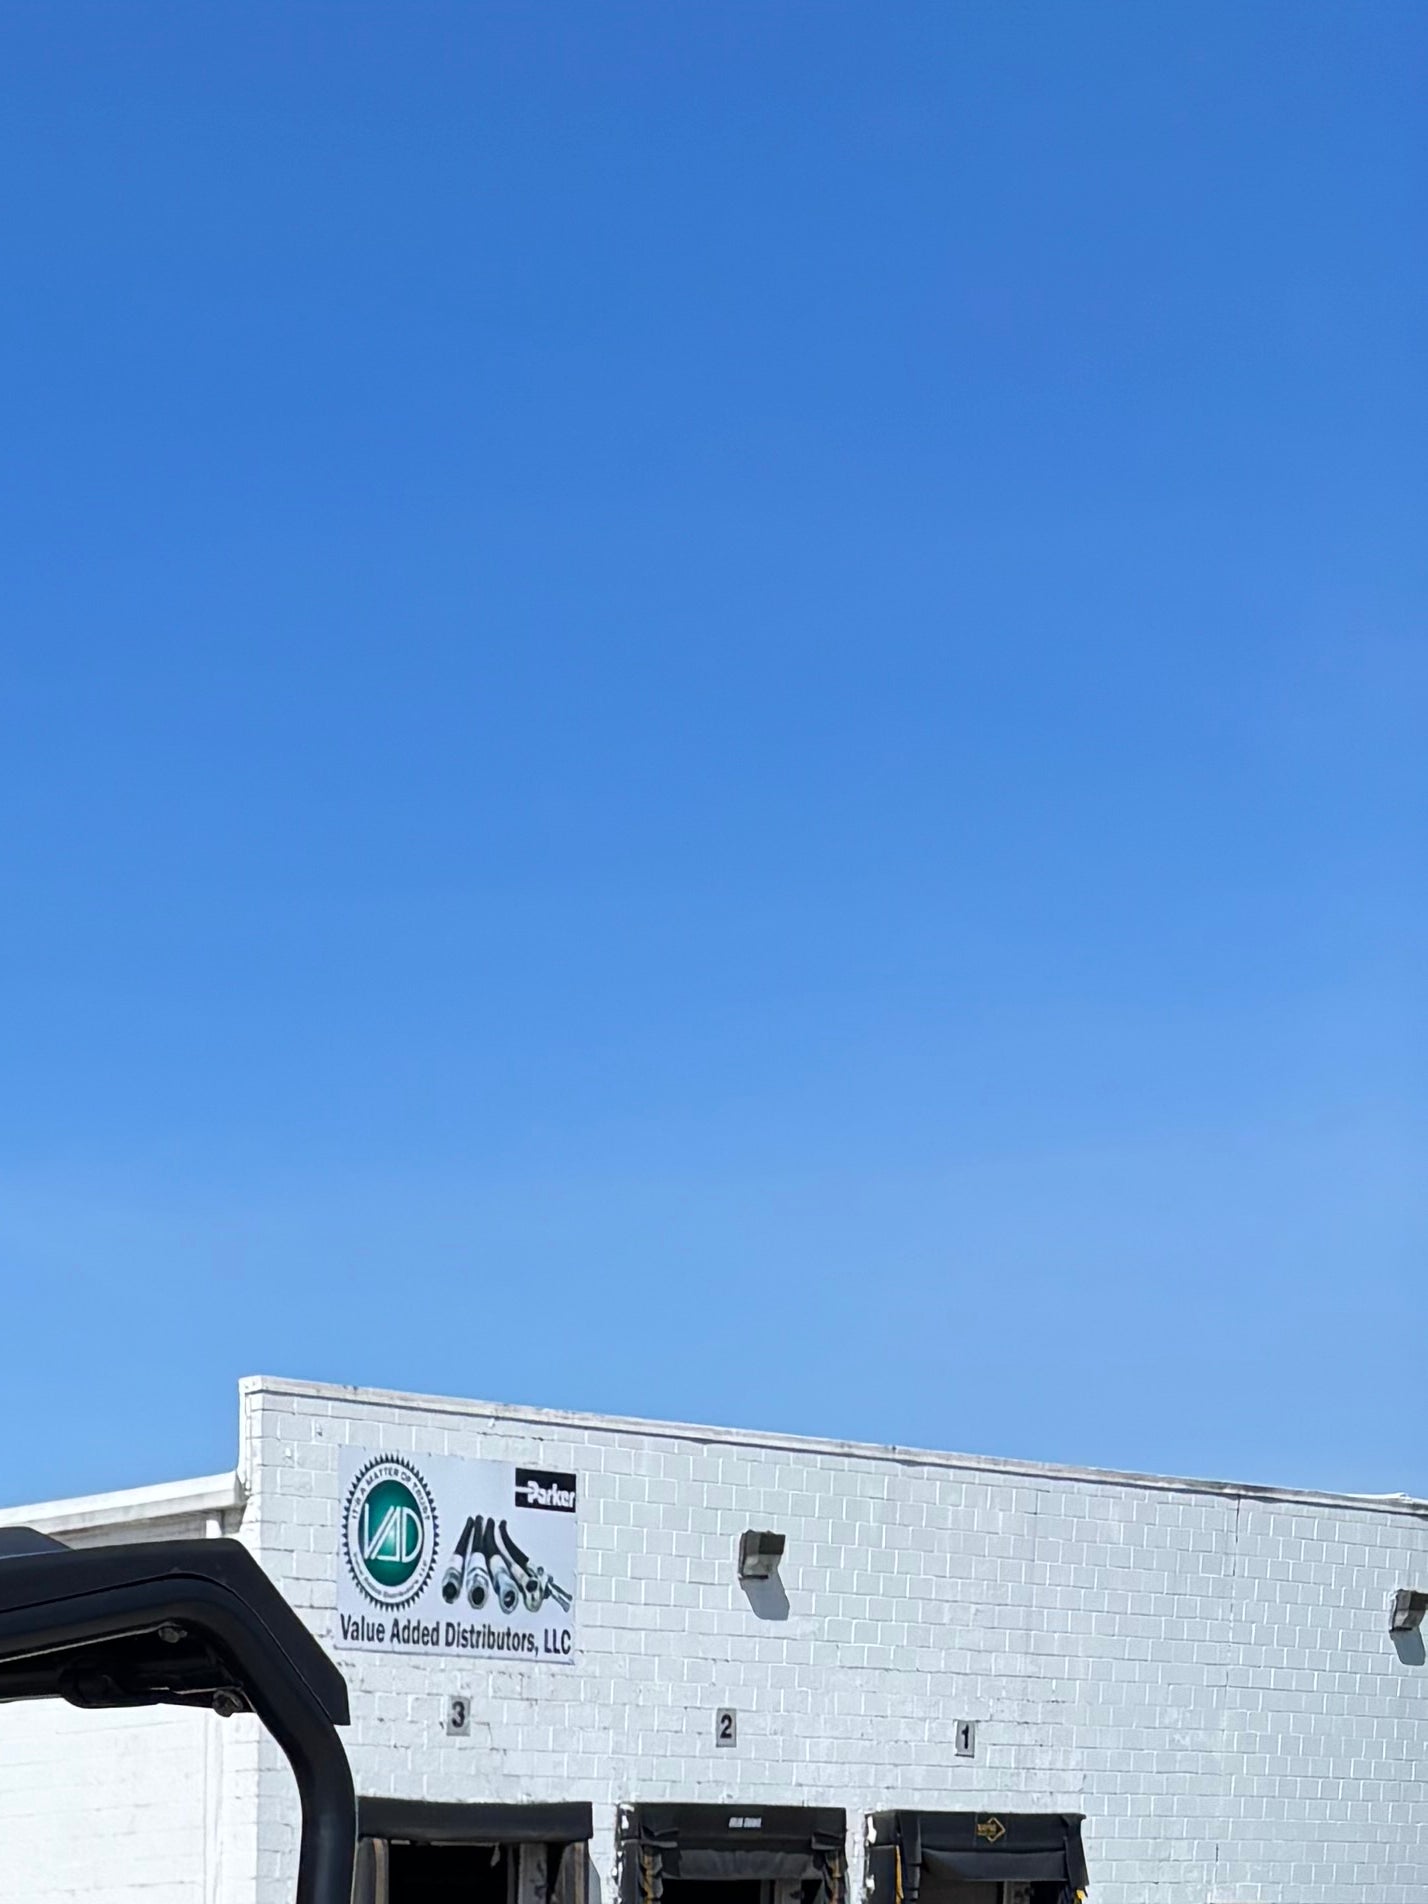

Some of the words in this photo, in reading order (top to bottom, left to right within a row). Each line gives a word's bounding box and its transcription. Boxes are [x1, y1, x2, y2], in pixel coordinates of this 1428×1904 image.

[527, 1480, 575, 1508] Parker
[364, 1503, 423, 1563] VAD
[340, 1614, 385, 1643] Value
[390, 1618, 440, 1646] Added
[445, 1621, 539, 1657] Distributors,
[545, 1628, 572, 1655] LLC
[451, 1701, 465, 1728] 3
[720, 1714, 732, 1739] 2
[962, 1724, 969, 1749] 1
